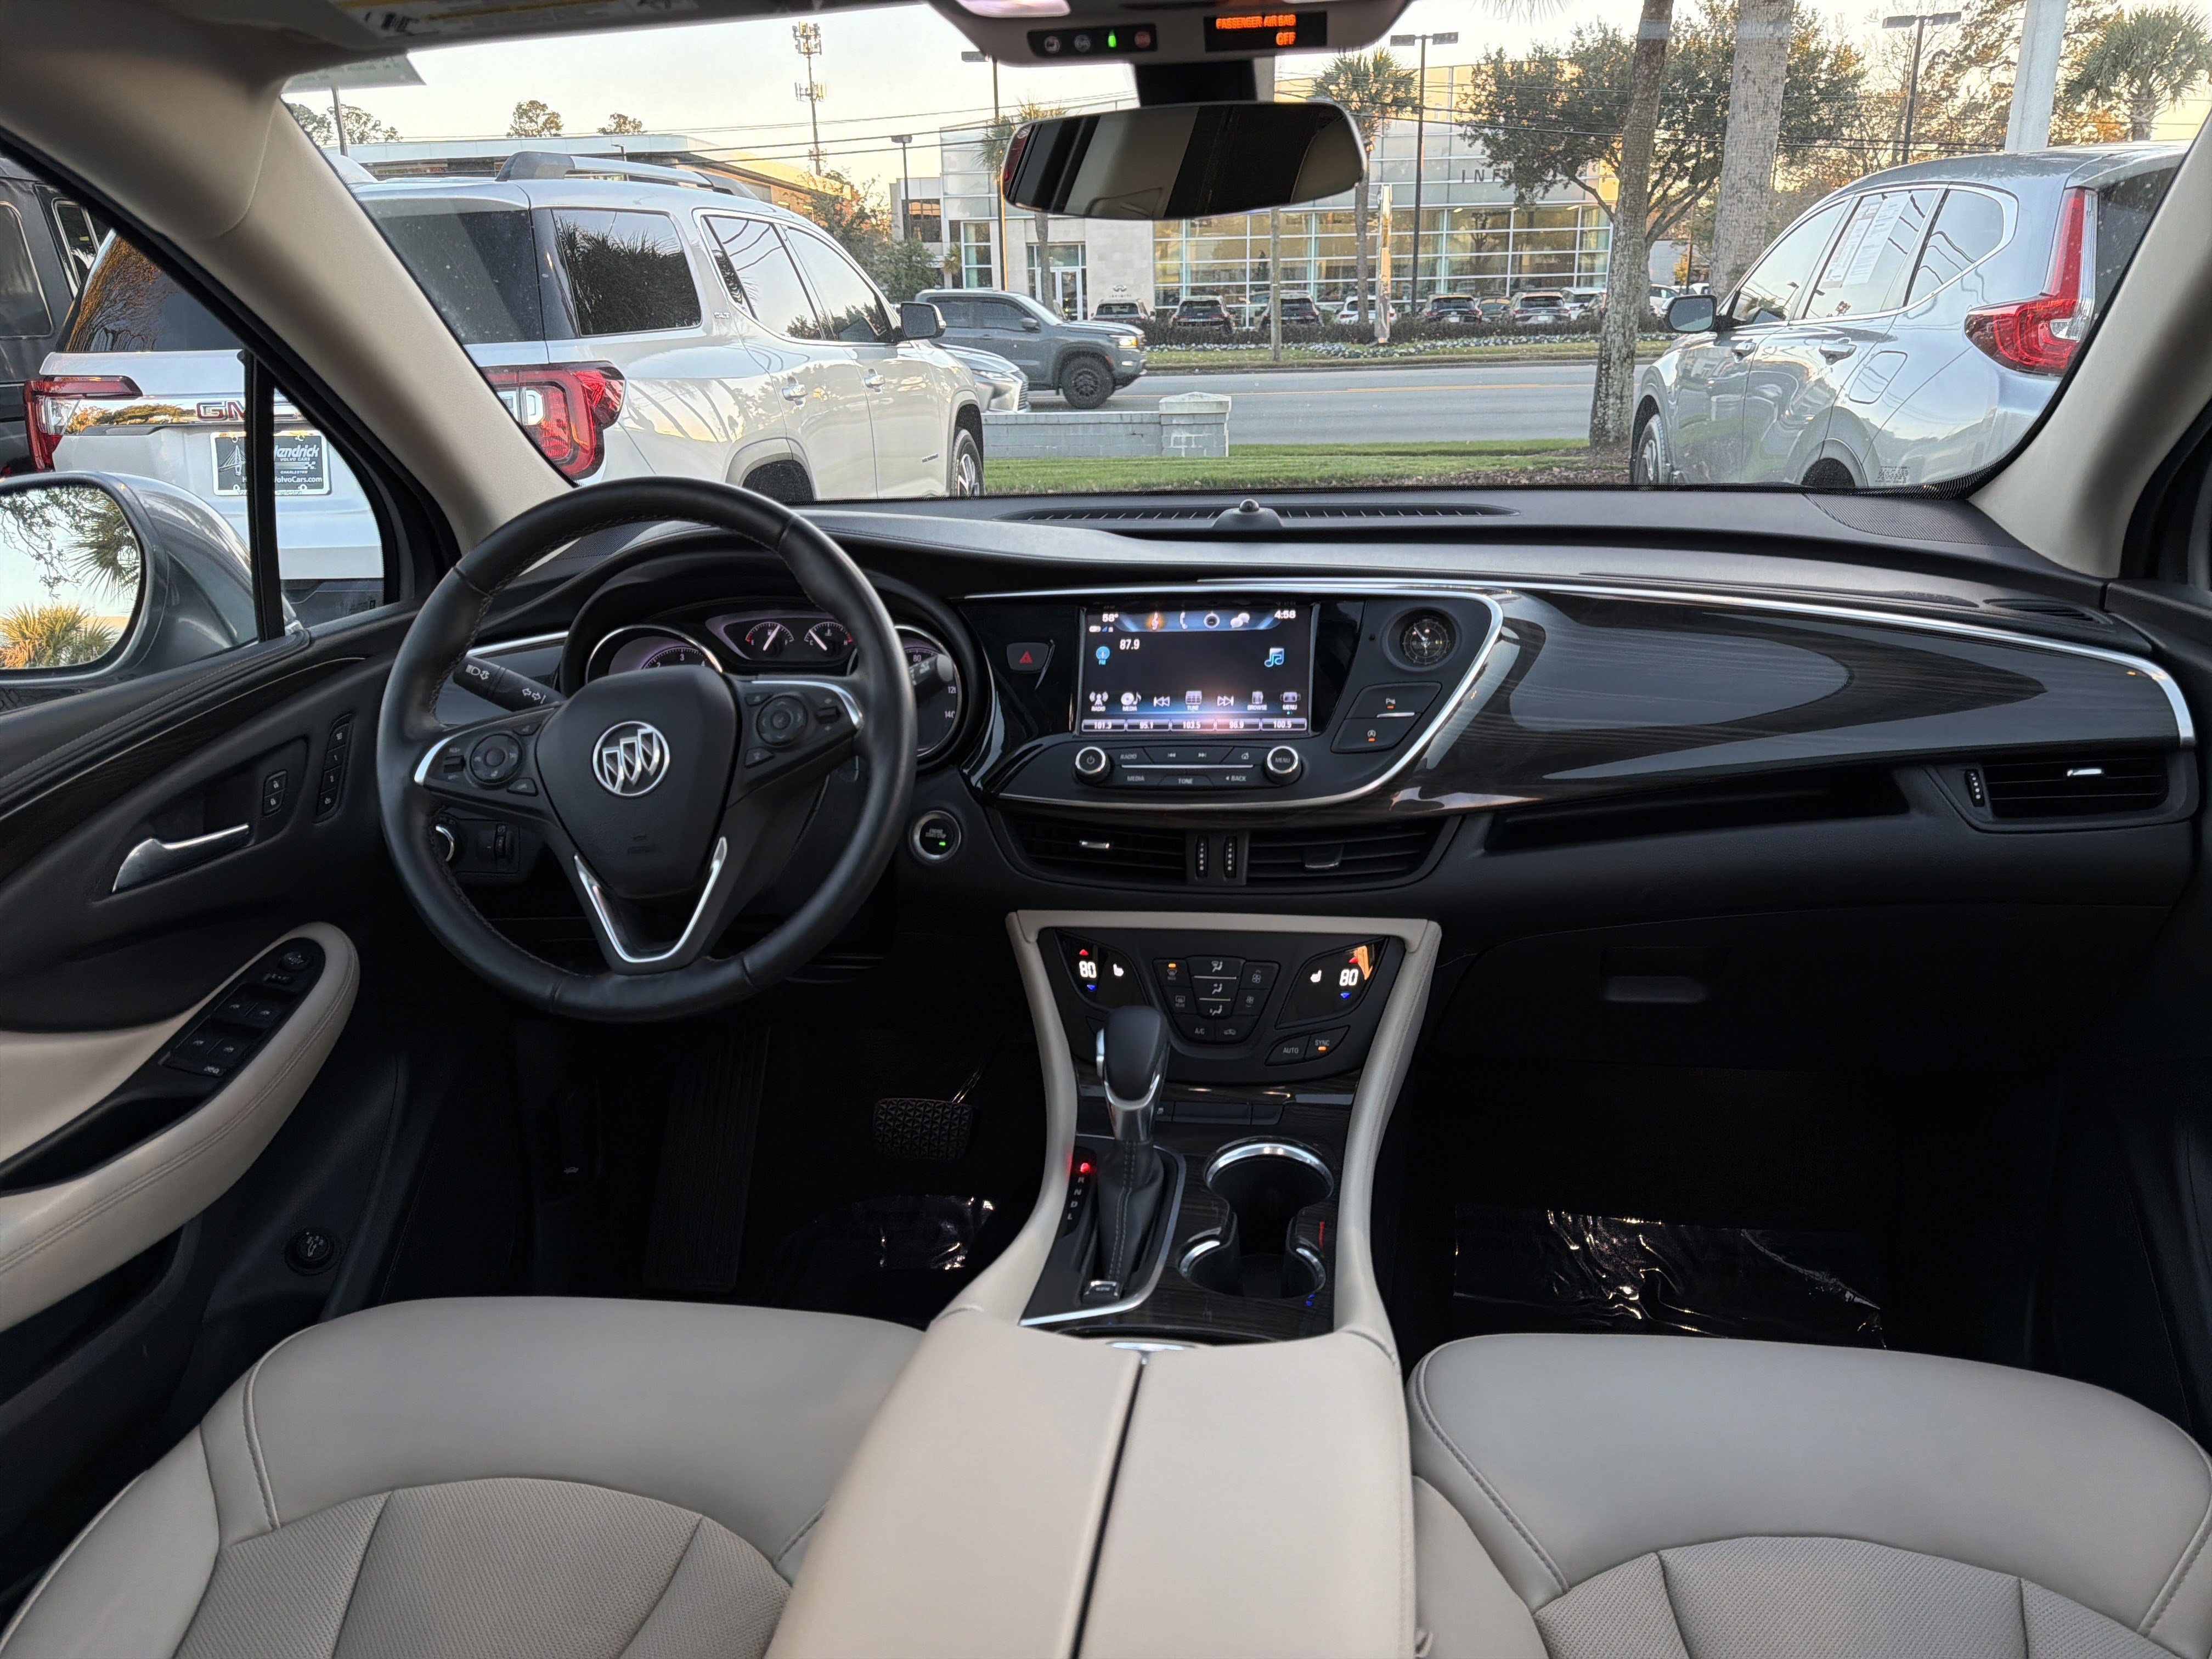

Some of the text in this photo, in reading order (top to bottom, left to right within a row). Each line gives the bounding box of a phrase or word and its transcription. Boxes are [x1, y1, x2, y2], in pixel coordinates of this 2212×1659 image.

[1216, 14, 1296, 29] PASSENGER AIR BAG
[1276, 32, 1296, 45] OFF
[1274, 610, 1296, 619] 4:58
[1120, 639, 1139, 650] 87.9
[680, 653, 685, 661] 3
[913, 654, 922, 662] 80
[1079, 961, 1097, 978] 80
[1339, 969, 1359, 986] 80
